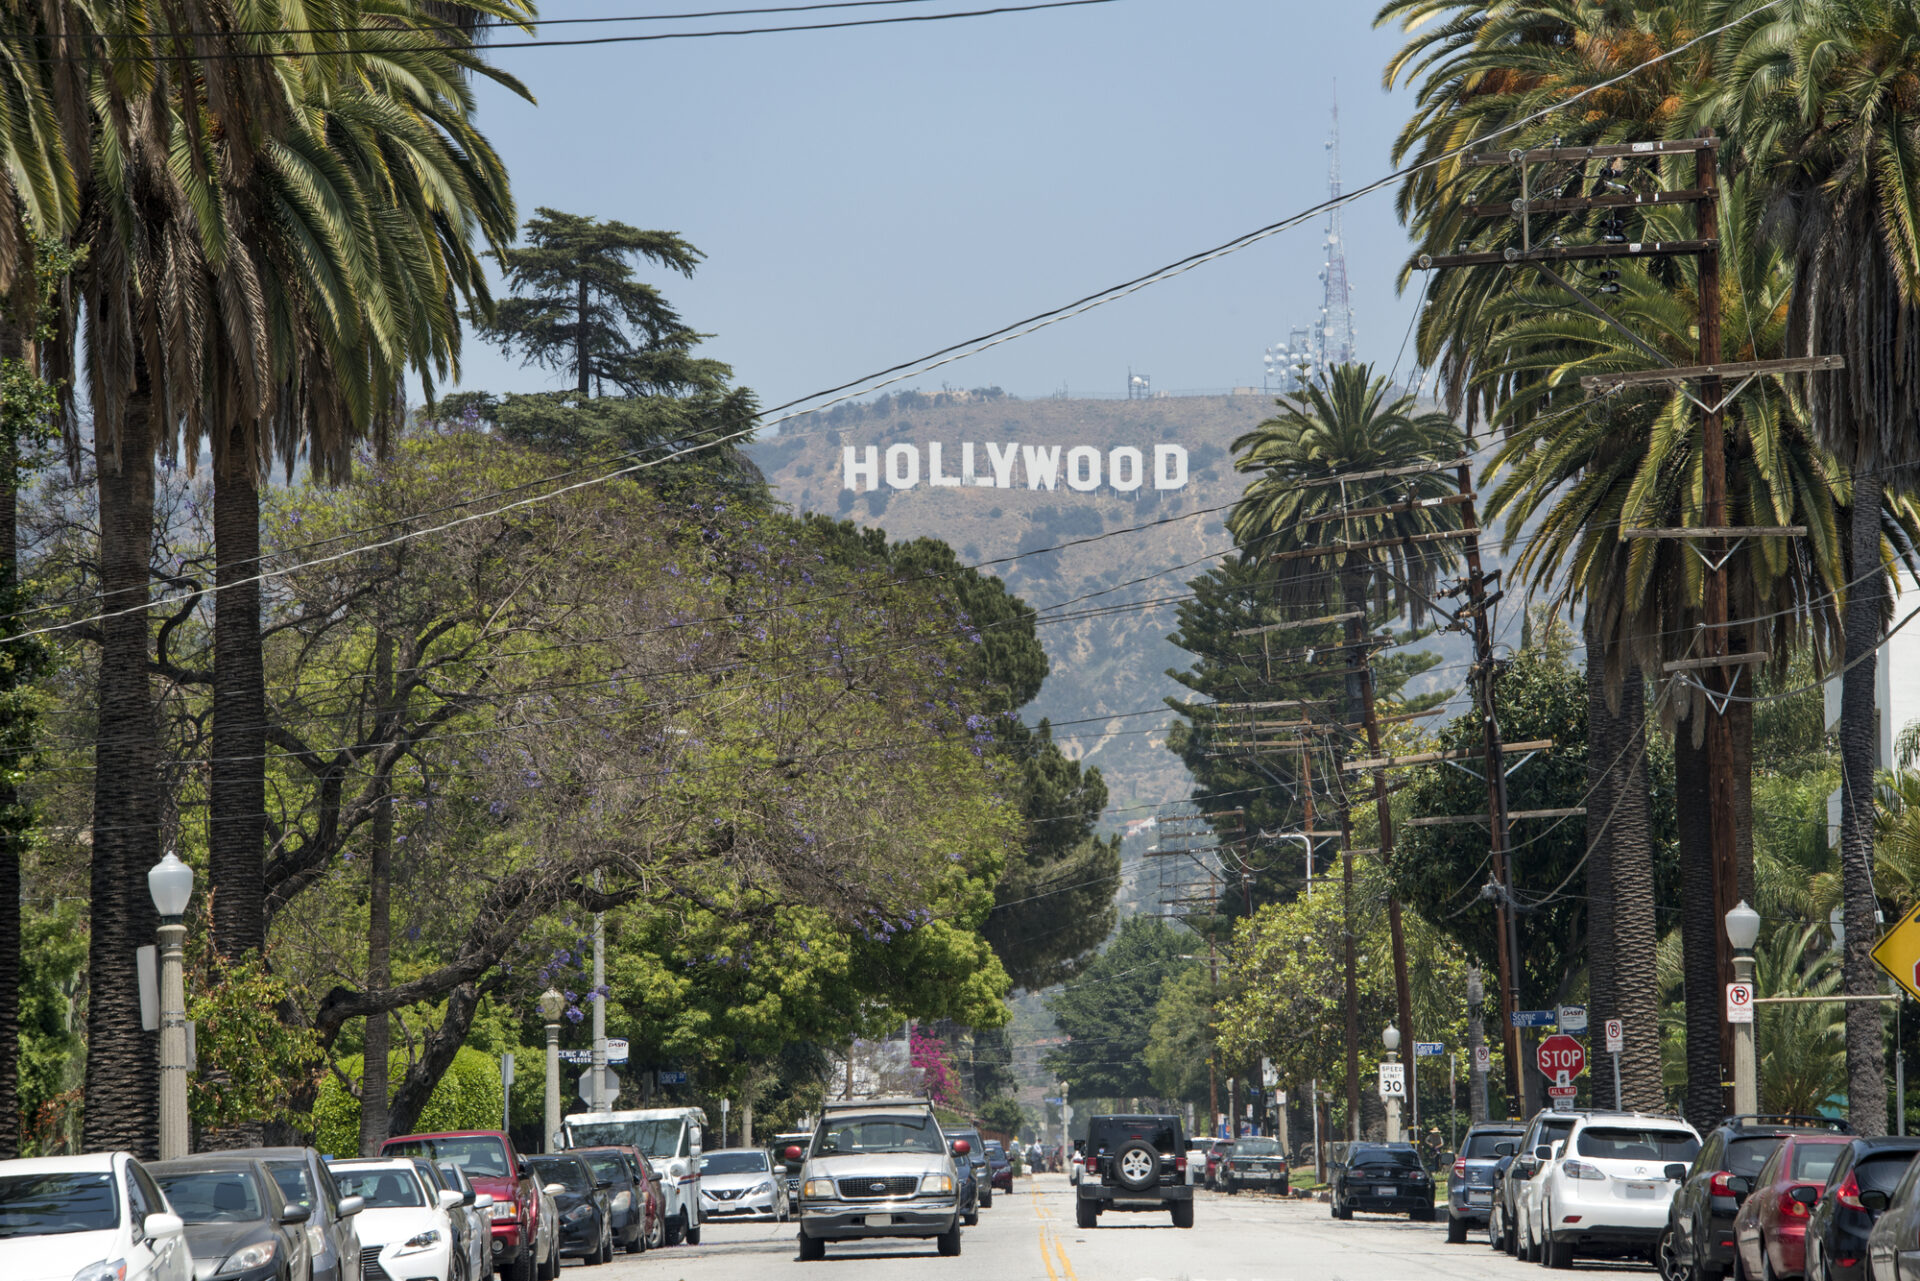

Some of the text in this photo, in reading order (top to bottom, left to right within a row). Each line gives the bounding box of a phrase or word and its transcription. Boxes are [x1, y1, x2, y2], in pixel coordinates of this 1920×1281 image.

[843, 441, 1189, 492] HOLLYWOOD
[1512, 1012, 1536, 1020] Scenic
[558, 1050, 592, 1058] CENIC AVE
[1541, 1050, 1582, 1067] STOP
[1384, 1081, 1402, 1092] 30
